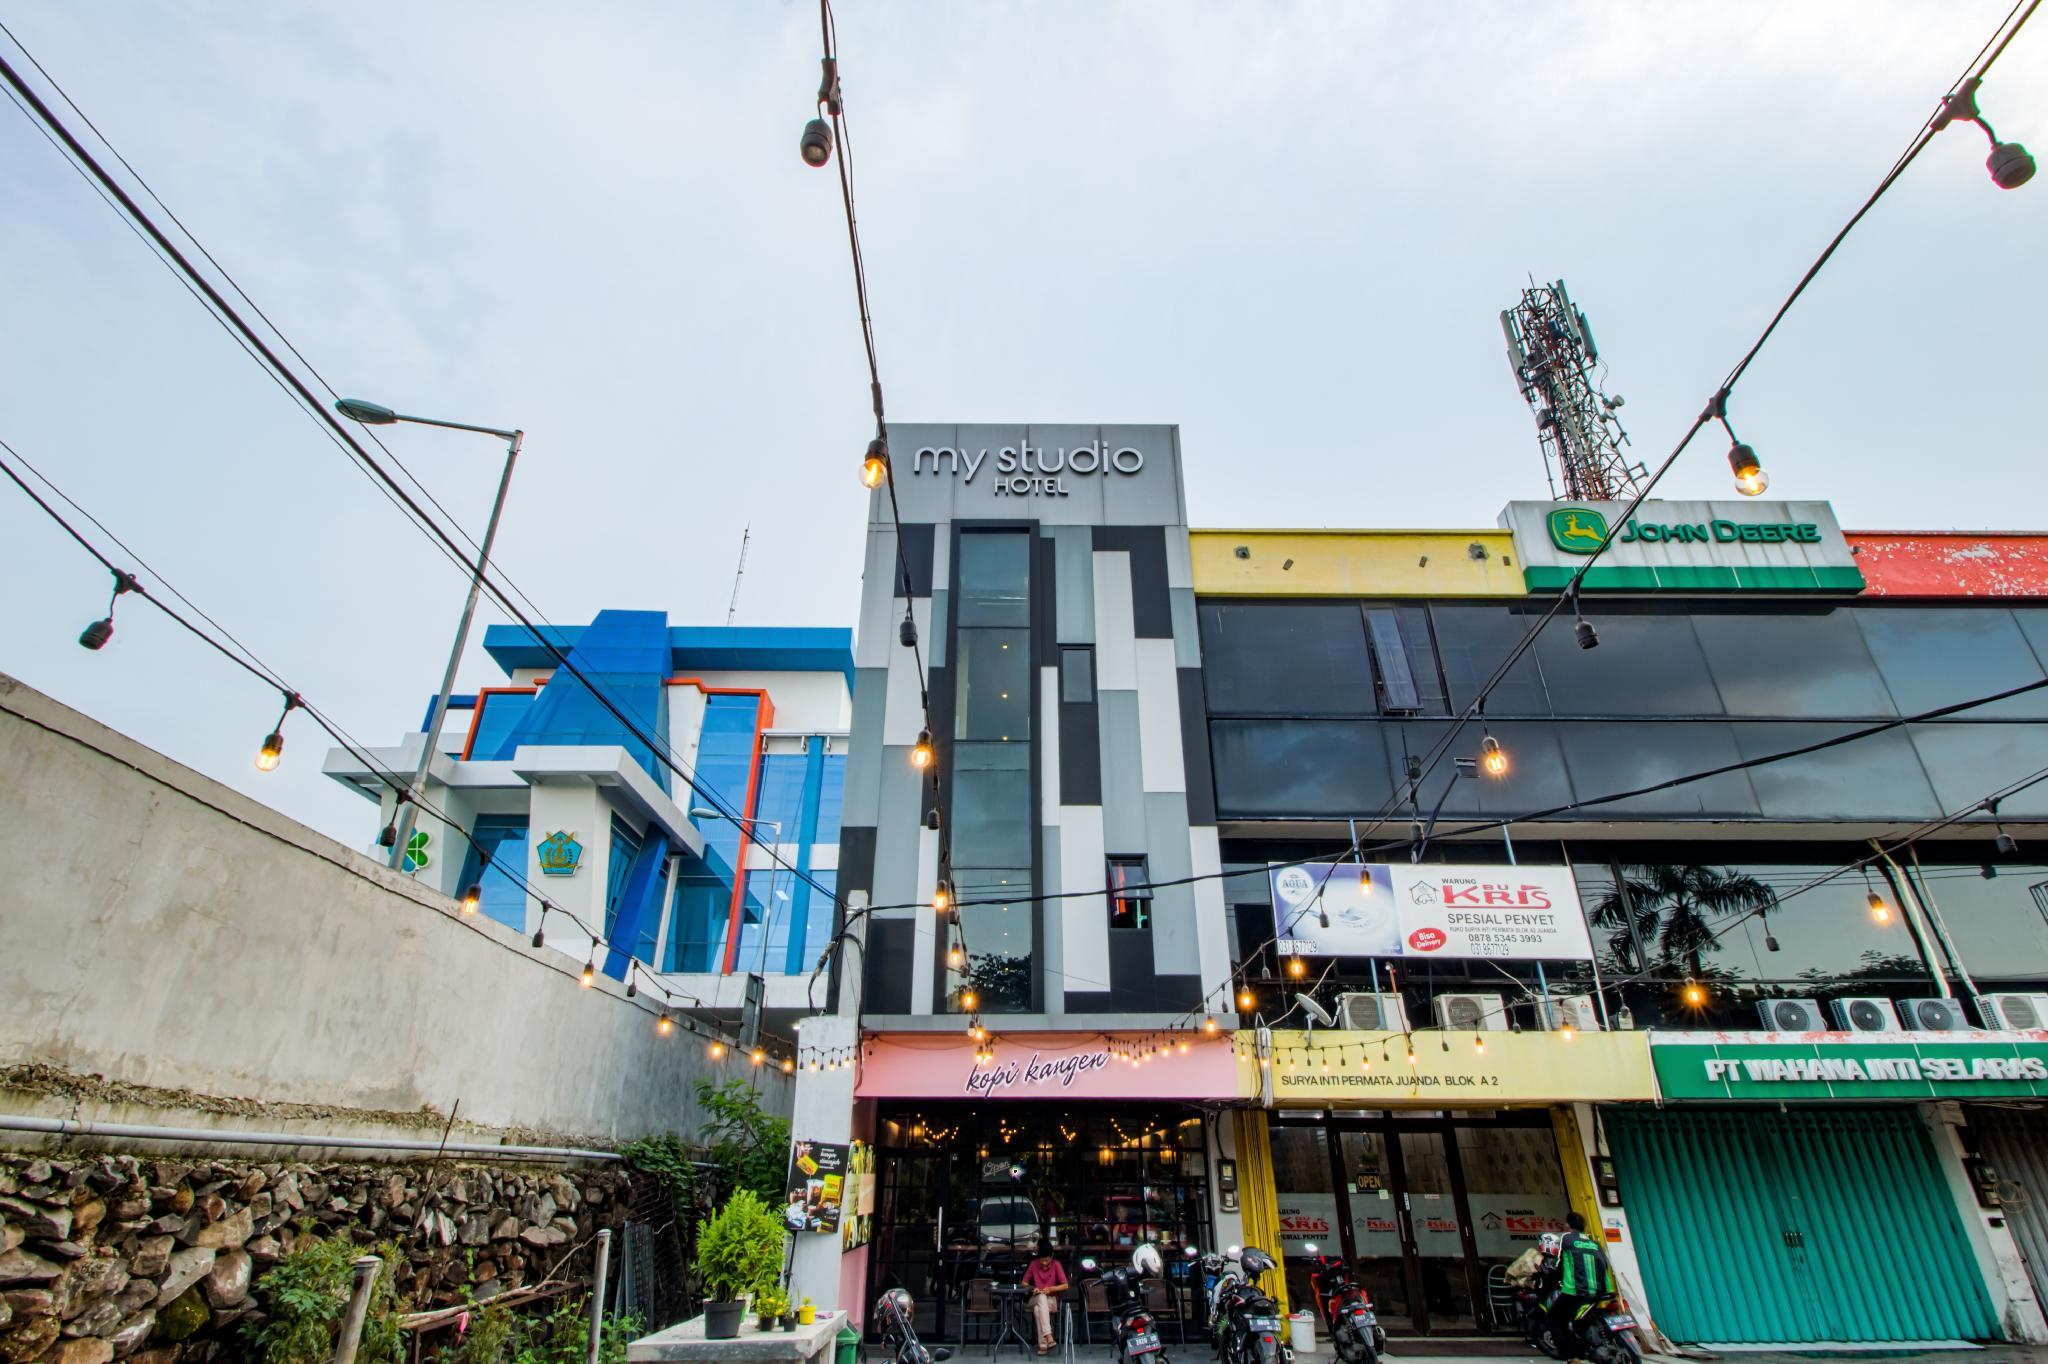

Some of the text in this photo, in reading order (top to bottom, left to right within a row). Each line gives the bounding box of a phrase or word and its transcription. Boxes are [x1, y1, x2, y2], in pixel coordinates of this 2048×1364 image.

[913, 440, 1144, 483] my studio
[994, 477, 1068, 495] HOTEL
[1621, 520, 1821, 543] JOHN DEERE
[1283, 879, 1309, 888] AQUA
[1448, 913, 1555, 926] SPESIAL PENYET
[1416, 938, 1441, 949] Delivery
[1468, 933, 1542, 943] 0878 5345 3993
[966, 1051, 1111, 1096] kopi kangen
[1703, 1058, 2048, 1081] PT WAHANA INTI SELARAS
[1281, 1076, 1499, 1086] SURYA INTI PERMATA JUANDA BLOK A 2
[983, 1161, 1011, 1177] Open
[1358, 1175, 1381, 1188] OPEN
